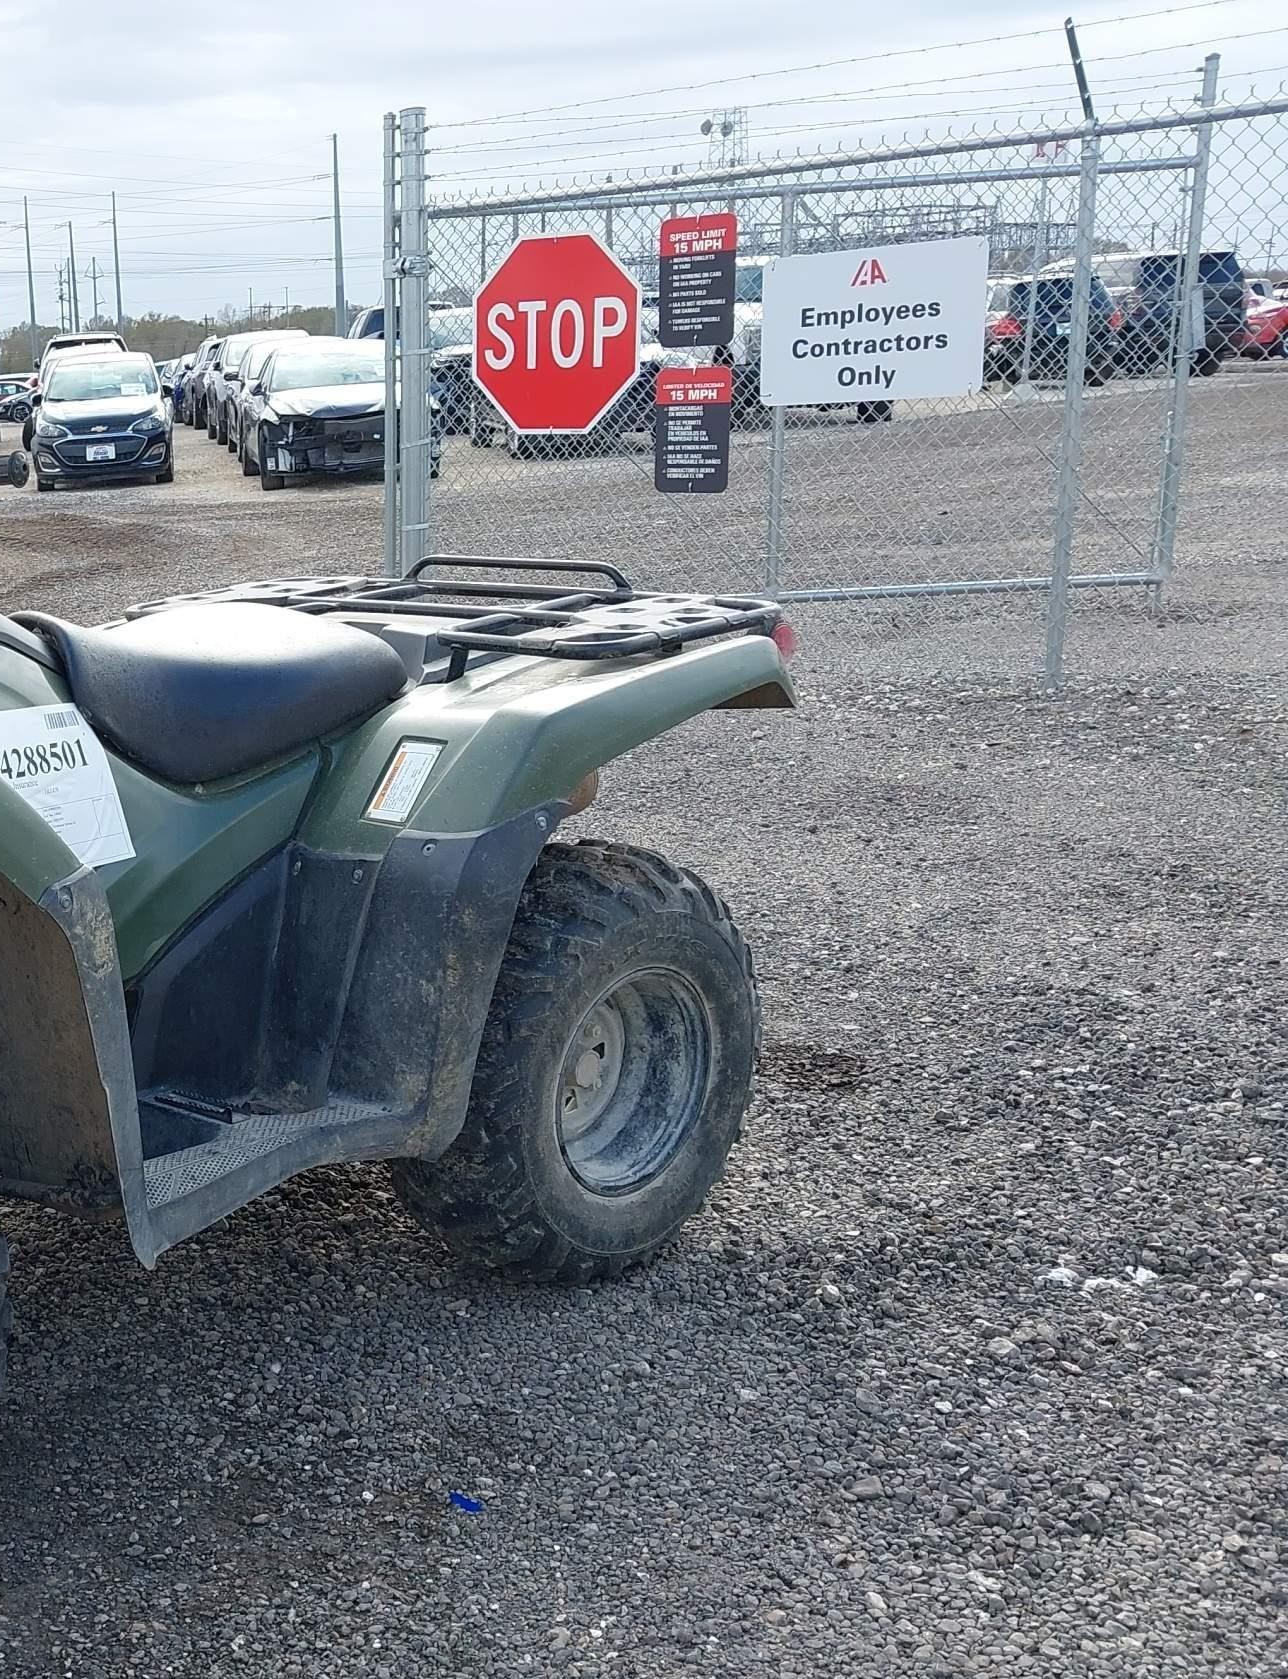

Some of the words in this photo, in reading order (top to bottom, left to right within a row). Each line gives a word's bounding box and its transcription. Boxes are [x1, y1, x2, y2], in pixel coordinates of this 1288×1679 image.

[670, 231, 699, 242] SPEED
[701, 228, 727, 239] LIMIT
[674, 242, 688, 254] 15
[692, 238, 722, 252] MPH
[801, 302, 942, 329] Employees
[484, 296, 628, 370] STOP
[792, 332, 948, 359] Contractors
[838, 364, 896, 389] Only
[670, 391, 683, 400] 15
[688, 390, 717, 400] MPH
